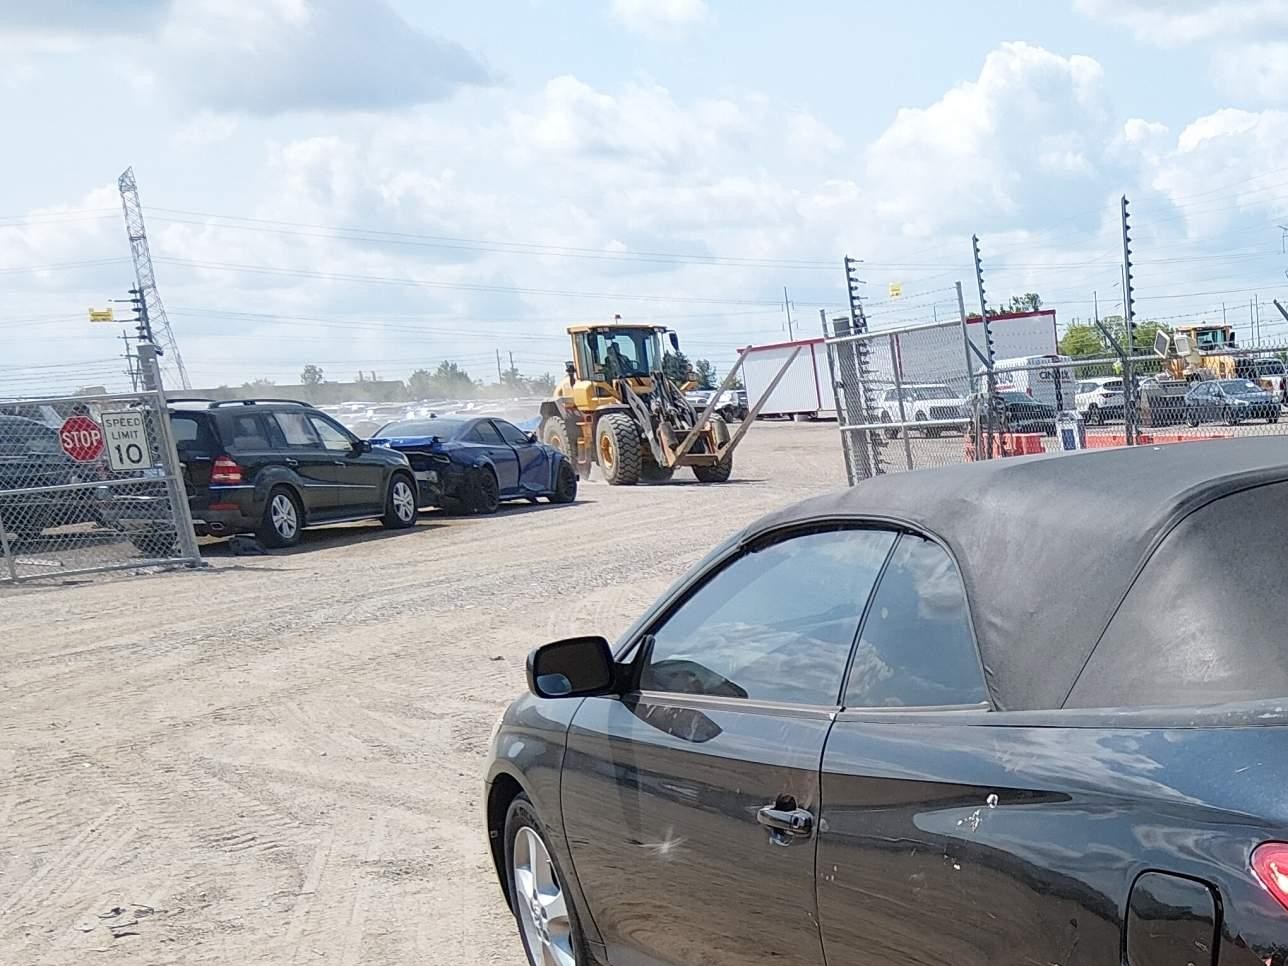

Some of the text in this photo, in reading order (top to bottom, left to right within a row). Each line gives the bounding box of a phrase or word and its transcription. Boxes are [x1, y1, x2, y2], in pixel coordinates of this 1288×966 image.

[105, 418, 141, 427] SPEED
[63, 431, 101, 448] STOP
[111, 430, 139, 440] LIMIT
[114, 443, 143, 465] 10
